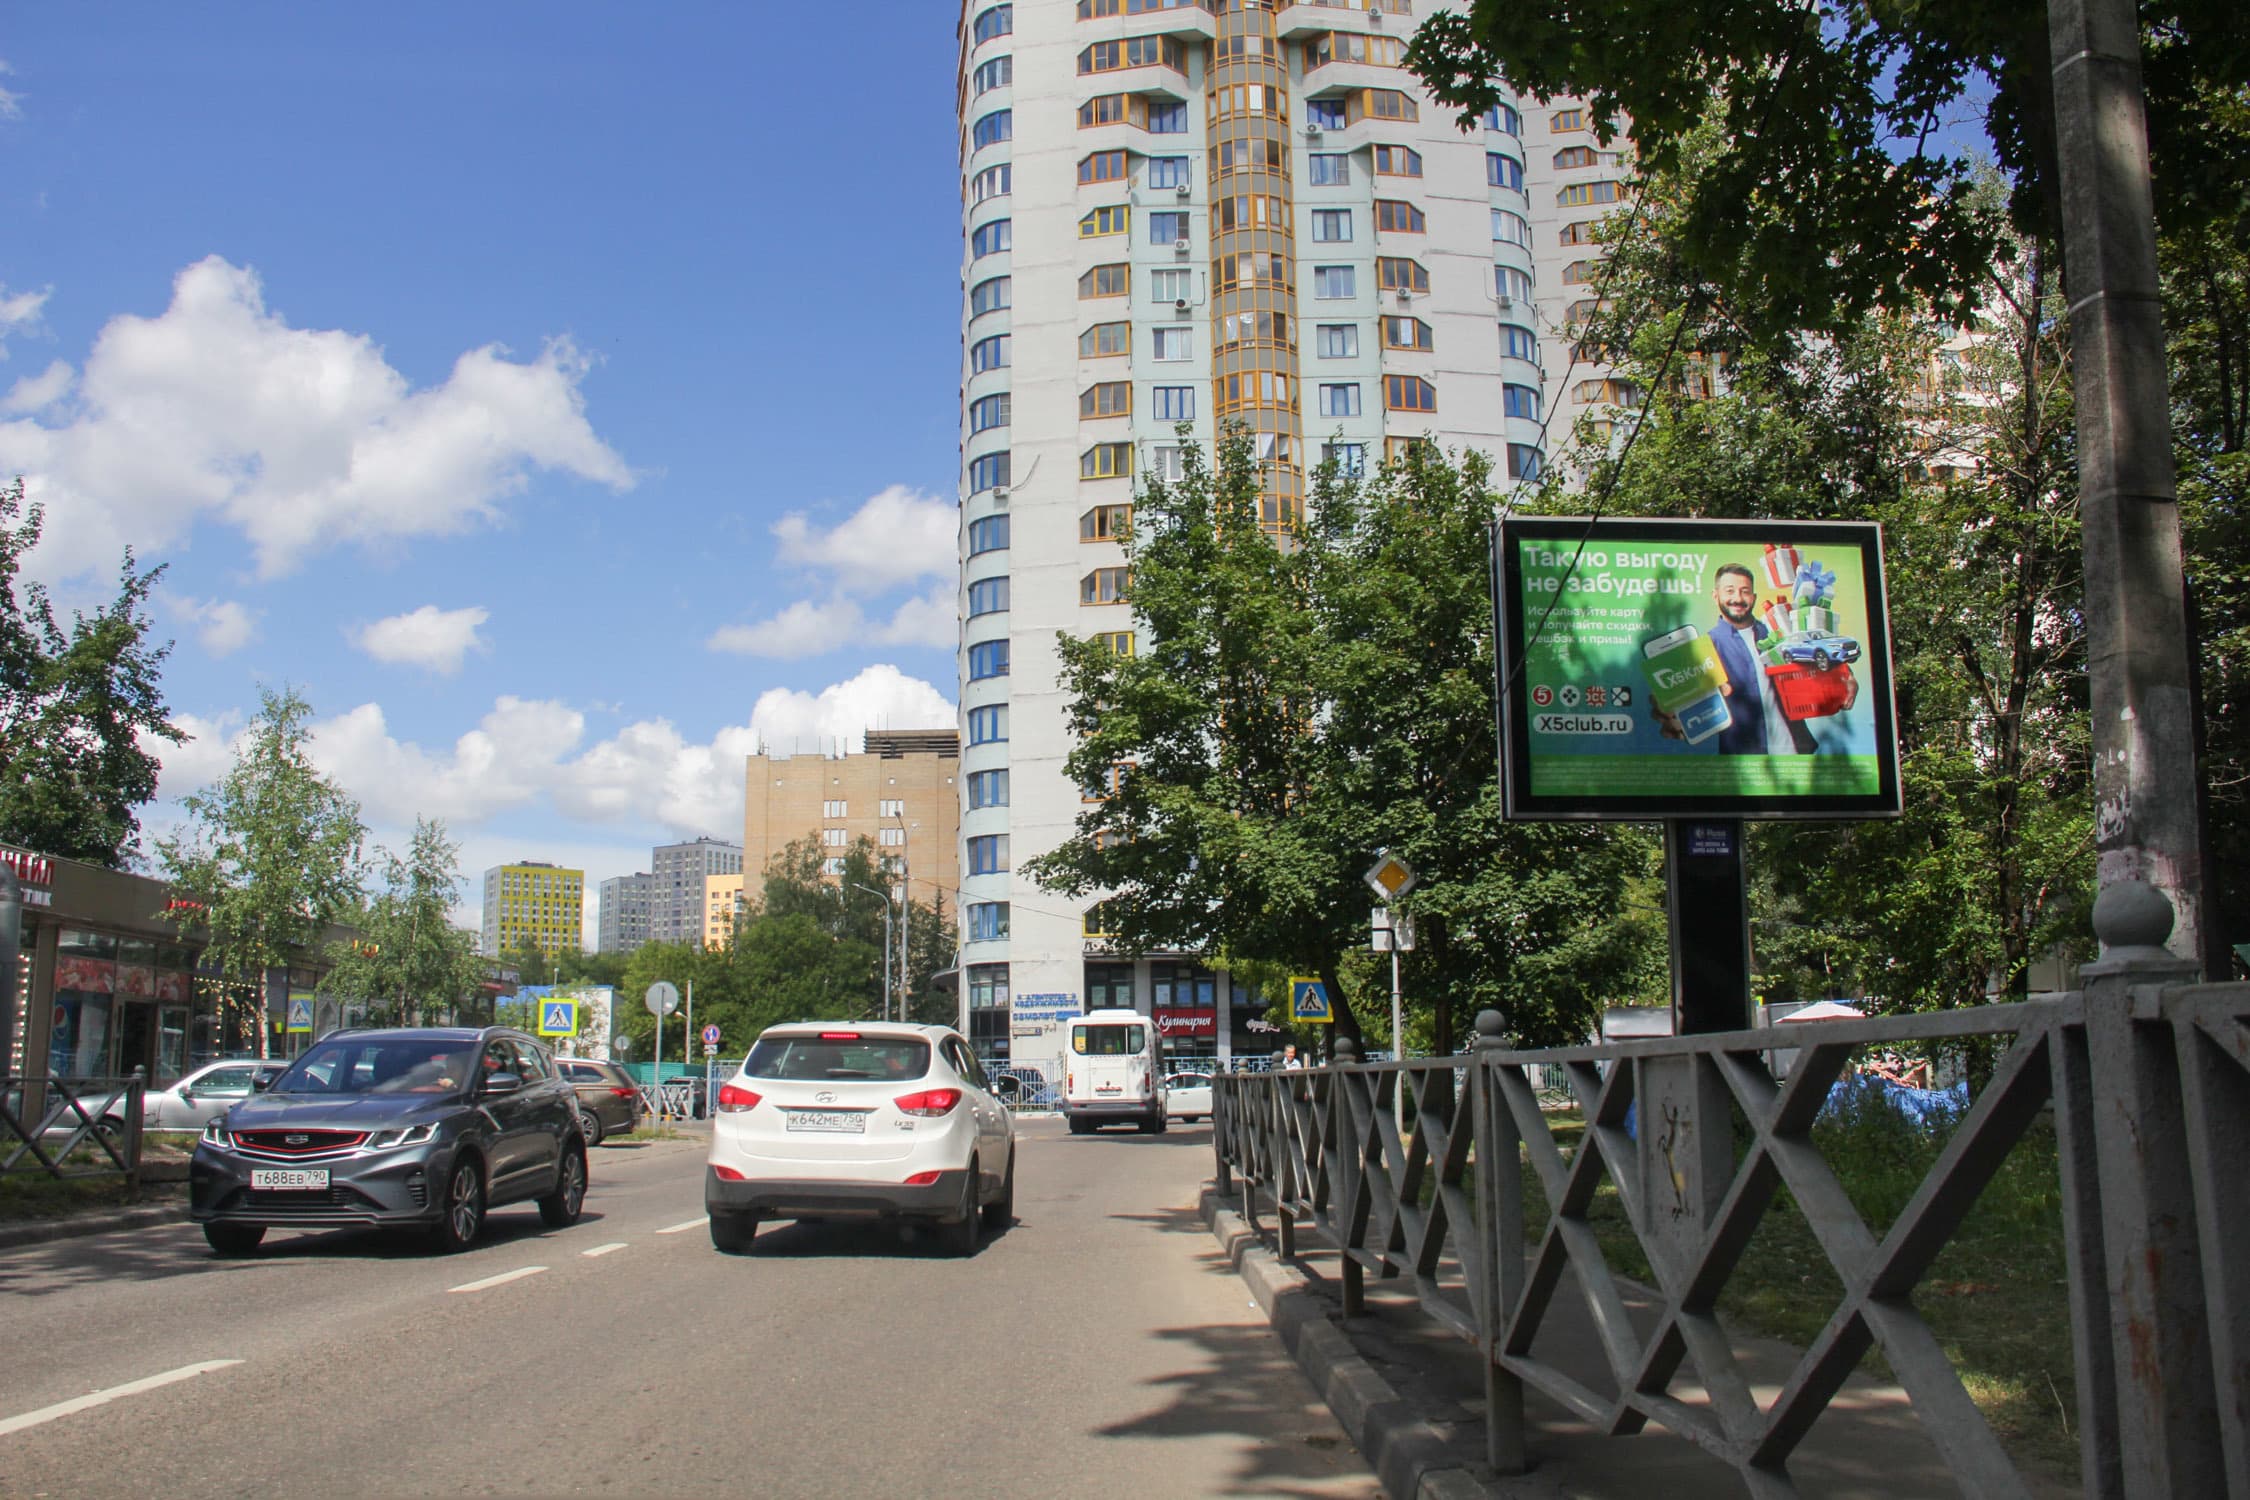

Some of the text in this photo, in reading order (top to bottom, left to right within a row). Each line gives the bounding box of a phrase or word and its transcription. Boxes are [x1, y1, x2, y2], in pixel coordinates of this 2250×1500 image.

[1524, 547, 1708, 574] Такую выгоду
[1527, 572, 1702, 598] не забудешь!
[1610, 608, 1645, 619] карту
[1589, 635, 1632, 646] призы!
[1540, 716, 1627, 731] X5club.ru
[1158, 1015, 1212, 1033] Кулинария
[256, 1170, 326, 1185] Т688ЕВ 790
